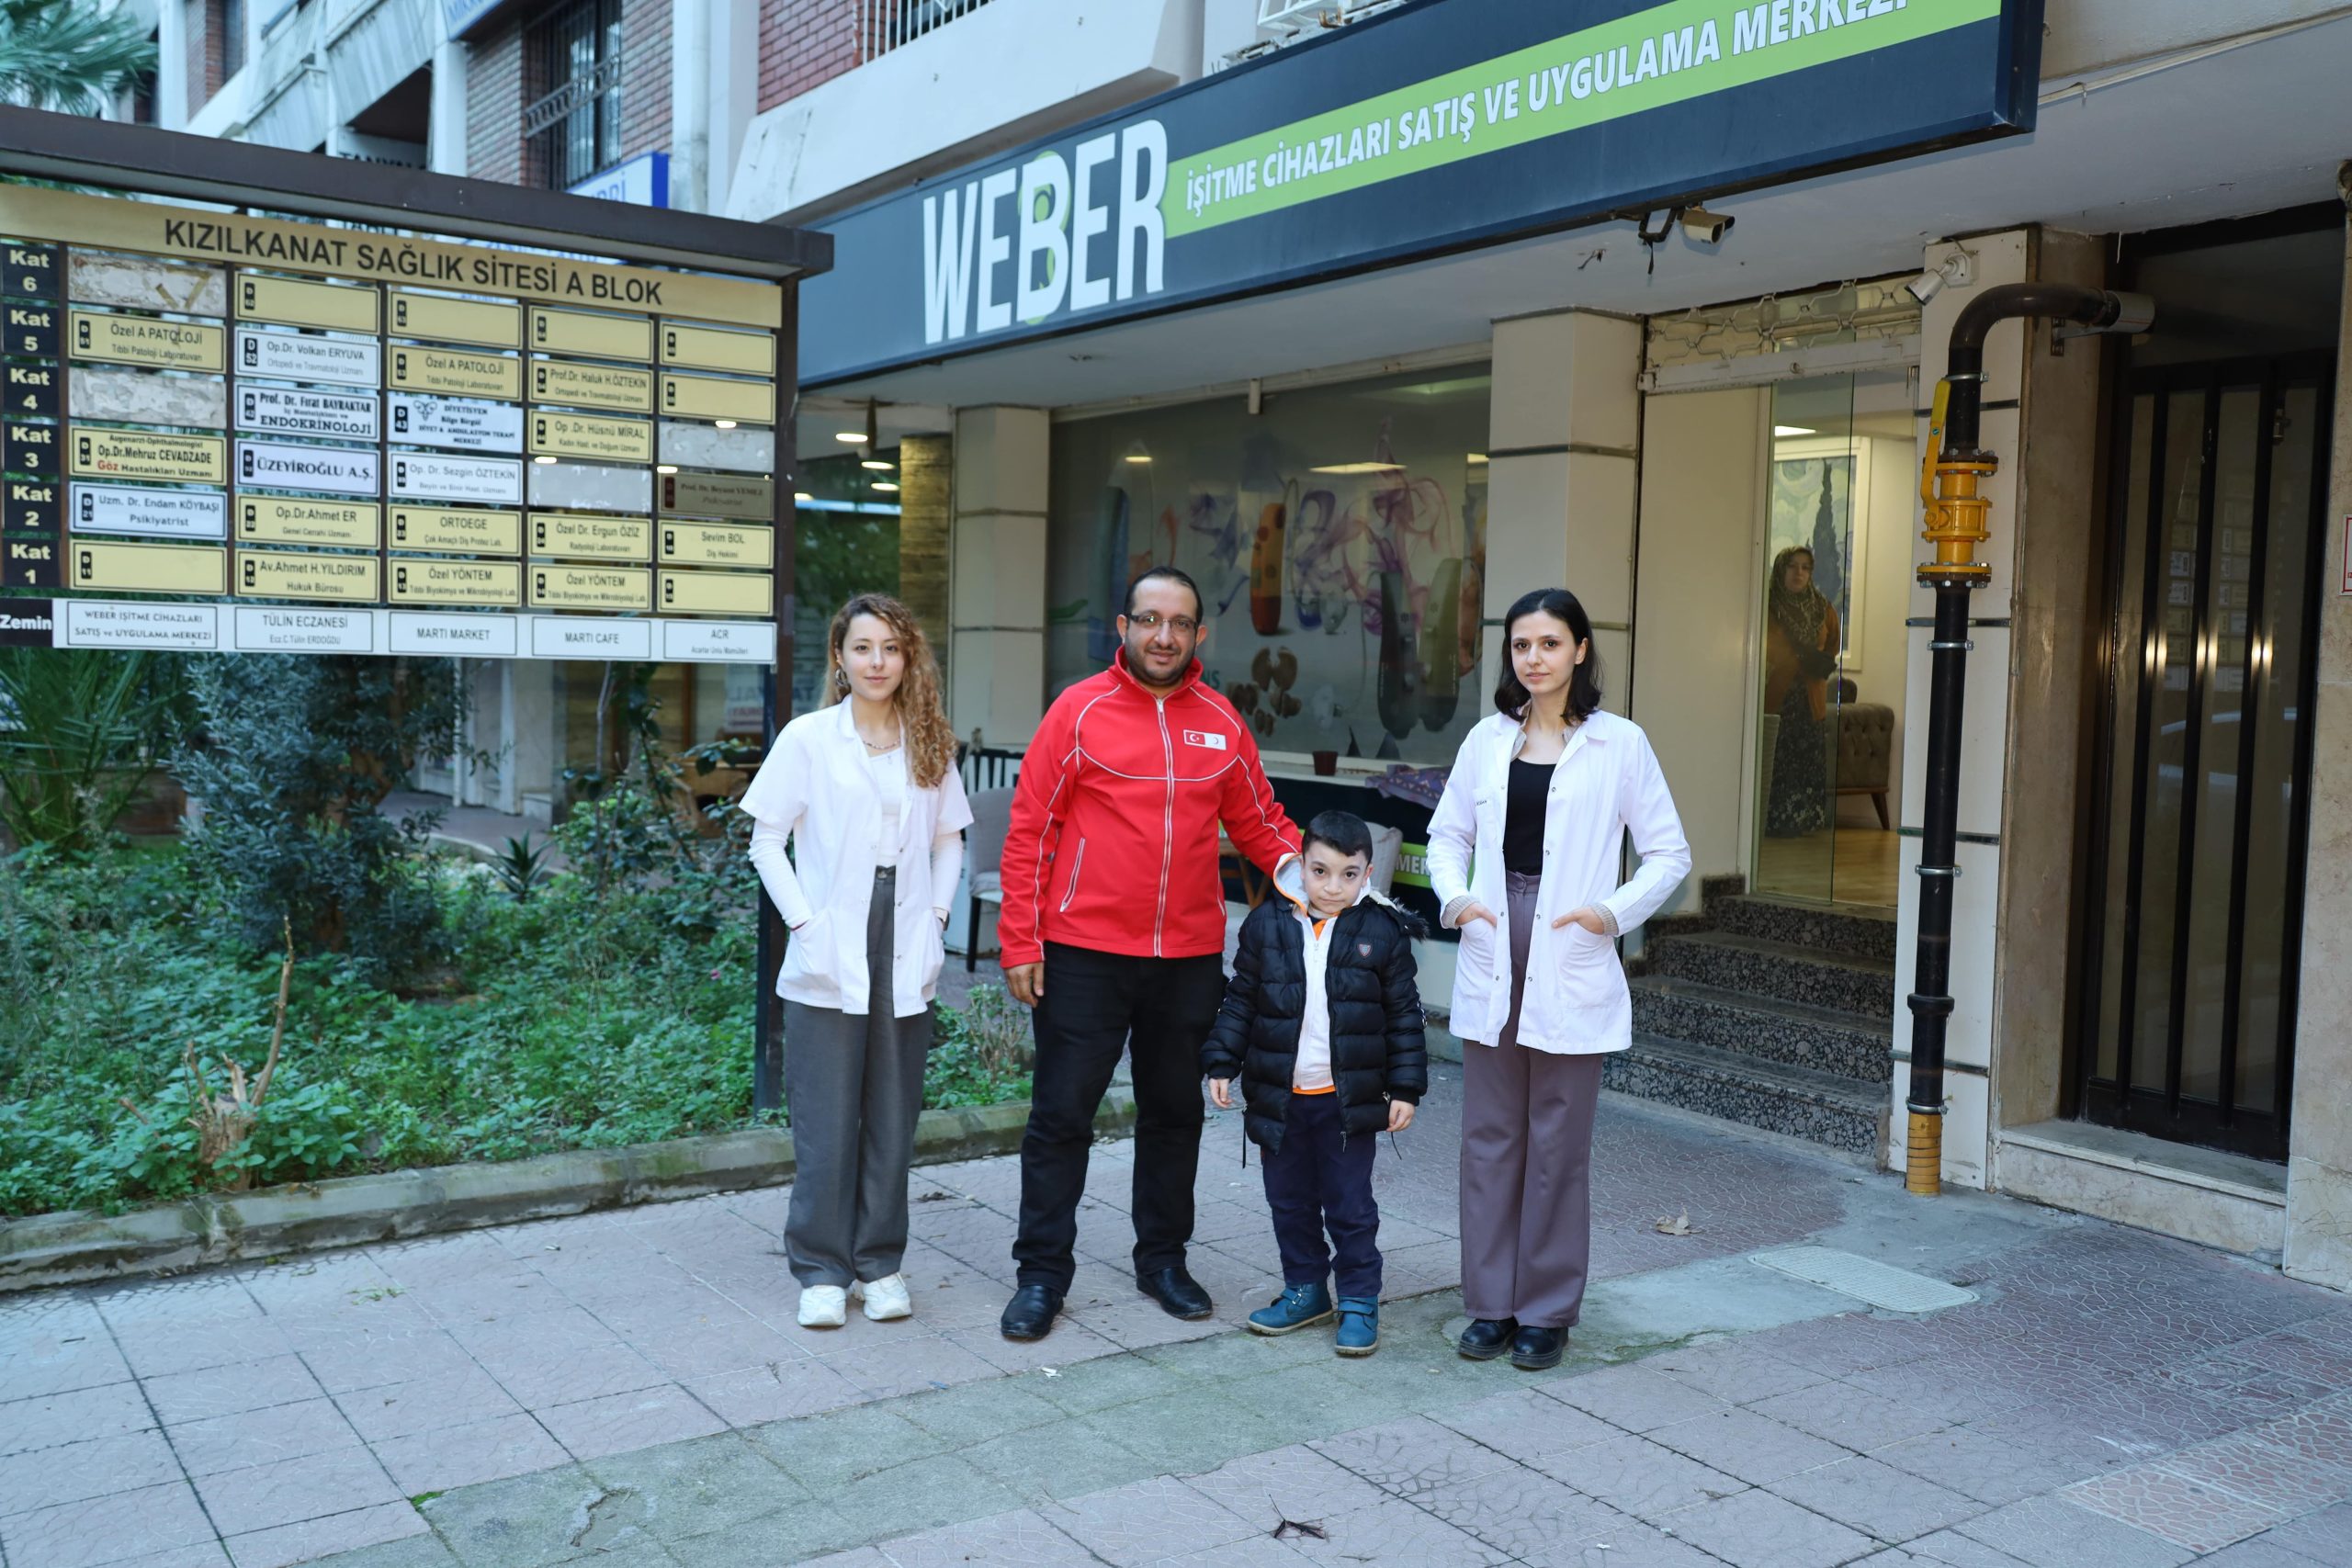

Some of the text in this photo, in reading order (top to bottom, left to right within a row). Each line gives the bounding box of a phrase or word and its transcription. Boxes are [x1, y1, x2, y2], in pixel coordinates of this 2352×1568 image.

[1186, 0, 1909, 217] İŞİTME CİHAZLARI SATIŞ VE UYGULAMA MERKE
[923, 119, 1168, 345] WEBER
[10, 250, 50, 268] Kat
[164, 219, 348, 266] KIZILKANAT
[357, 243, 463, 282] SAĞLIK
[473, 255, 557, 293] SİTESİ
[566, 271, 583, 296] A
[592, 274, 662, 305] BLOK
[23, 276, 37, 292] 6
[10, 310, 51, 328] Kat
[110, 321, 203, 344] Özel A PATOLOJİ
[24, 336, 39, 352] 5
[266, 341, 365, 360] Op.Dr. Volkan ERYUVA
[425, 355, 504, 375] Özel A PATOLOJİ
[10, 368, 51, 386] Kat
[582, 373, 603, 384] Haluk
[23, 395, 38, 410] 4
[260, 393, 371, 412] Prof. Dr. Fırat BAYRAKTAR
[260, 415, 372, 434] ENDOKRİNOLOJİ
[588, 423, 616, 436] Hüsnü
[12, 426, 51, 444] Kat
[25, 453, 40, 468] 3
[159, 449, 212, 464] CEVADZADE
[97, 459, 119, 471] Göz
[257, 457, 374, 480] ÜZEYİROĞLU A.Ş.
[428, 465, 440, 474] Dr.
[444, 466, 473, 478] Sezgin
[476, 467, 515, 479] ÖZTEKİN
[13, 486, 52, 502] Kat
[99, 495, 220, 513] Uzm. Dr. Endam KÖYBAŞI
[25, 512, 40, 526] 2
[130, 514, 189, 526] Psikiyatrist
[343, 512, 356, 522] ER
[440, 516, 488, 530] ORTOEGE
[556, 522, 575, 535] Özel
[578, 525, 589, 536] Dr.
[593, 525, 617, 538] Ergun
[702, 532, 726, 543] Sevim
[11, 544, 51, 560] Kat
[25, 570, 36, 584] 1
[429, 567, 492, 581] Özel YÖNTEM
[567, 572, 625, 587] Özel YÖNTEM
[287, 582, 345, 593] Hukuk Bürosu
[0, 615, 52, 630] Zemin
[85, 610, 117, 620] WEBER
[263, 614, 348, 628] TÜLİN ECZANESİ
[116, 629, 169, 639] UYGULAMA
[417, 628, 490, 640] MARTI MARKET
[565, 632, 619, 644] MARTI CAFE
[711, 629, 729, 639] ACR
